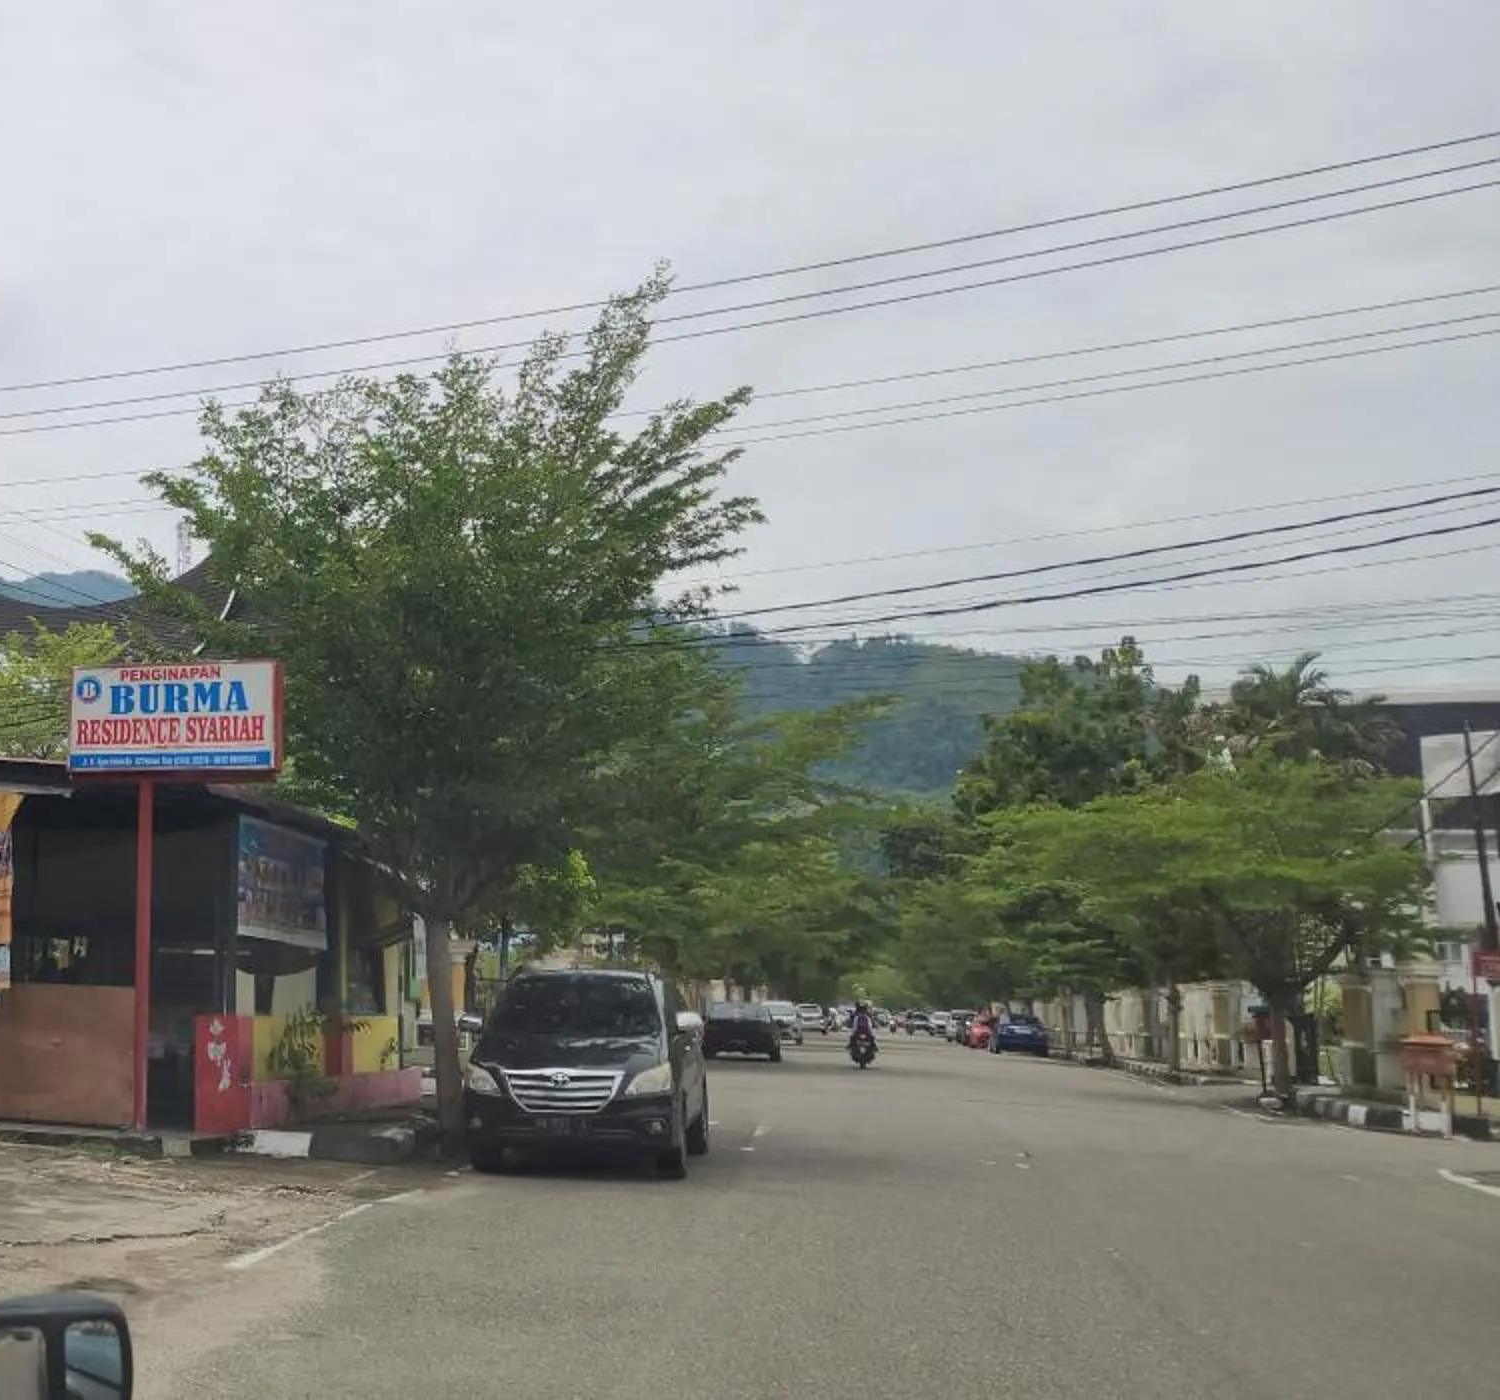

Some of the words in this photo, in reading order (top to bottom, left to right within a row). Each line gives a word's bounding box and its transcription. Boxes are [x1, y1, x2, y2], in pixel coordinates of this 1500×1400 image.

[120, 666, 221, 681] PENGINAPAN
[109, 680, 249, 715] BURMA
[77, 717, 180, 745] RESIDENCE
[186, 715, 265, 743] SYARIAH
